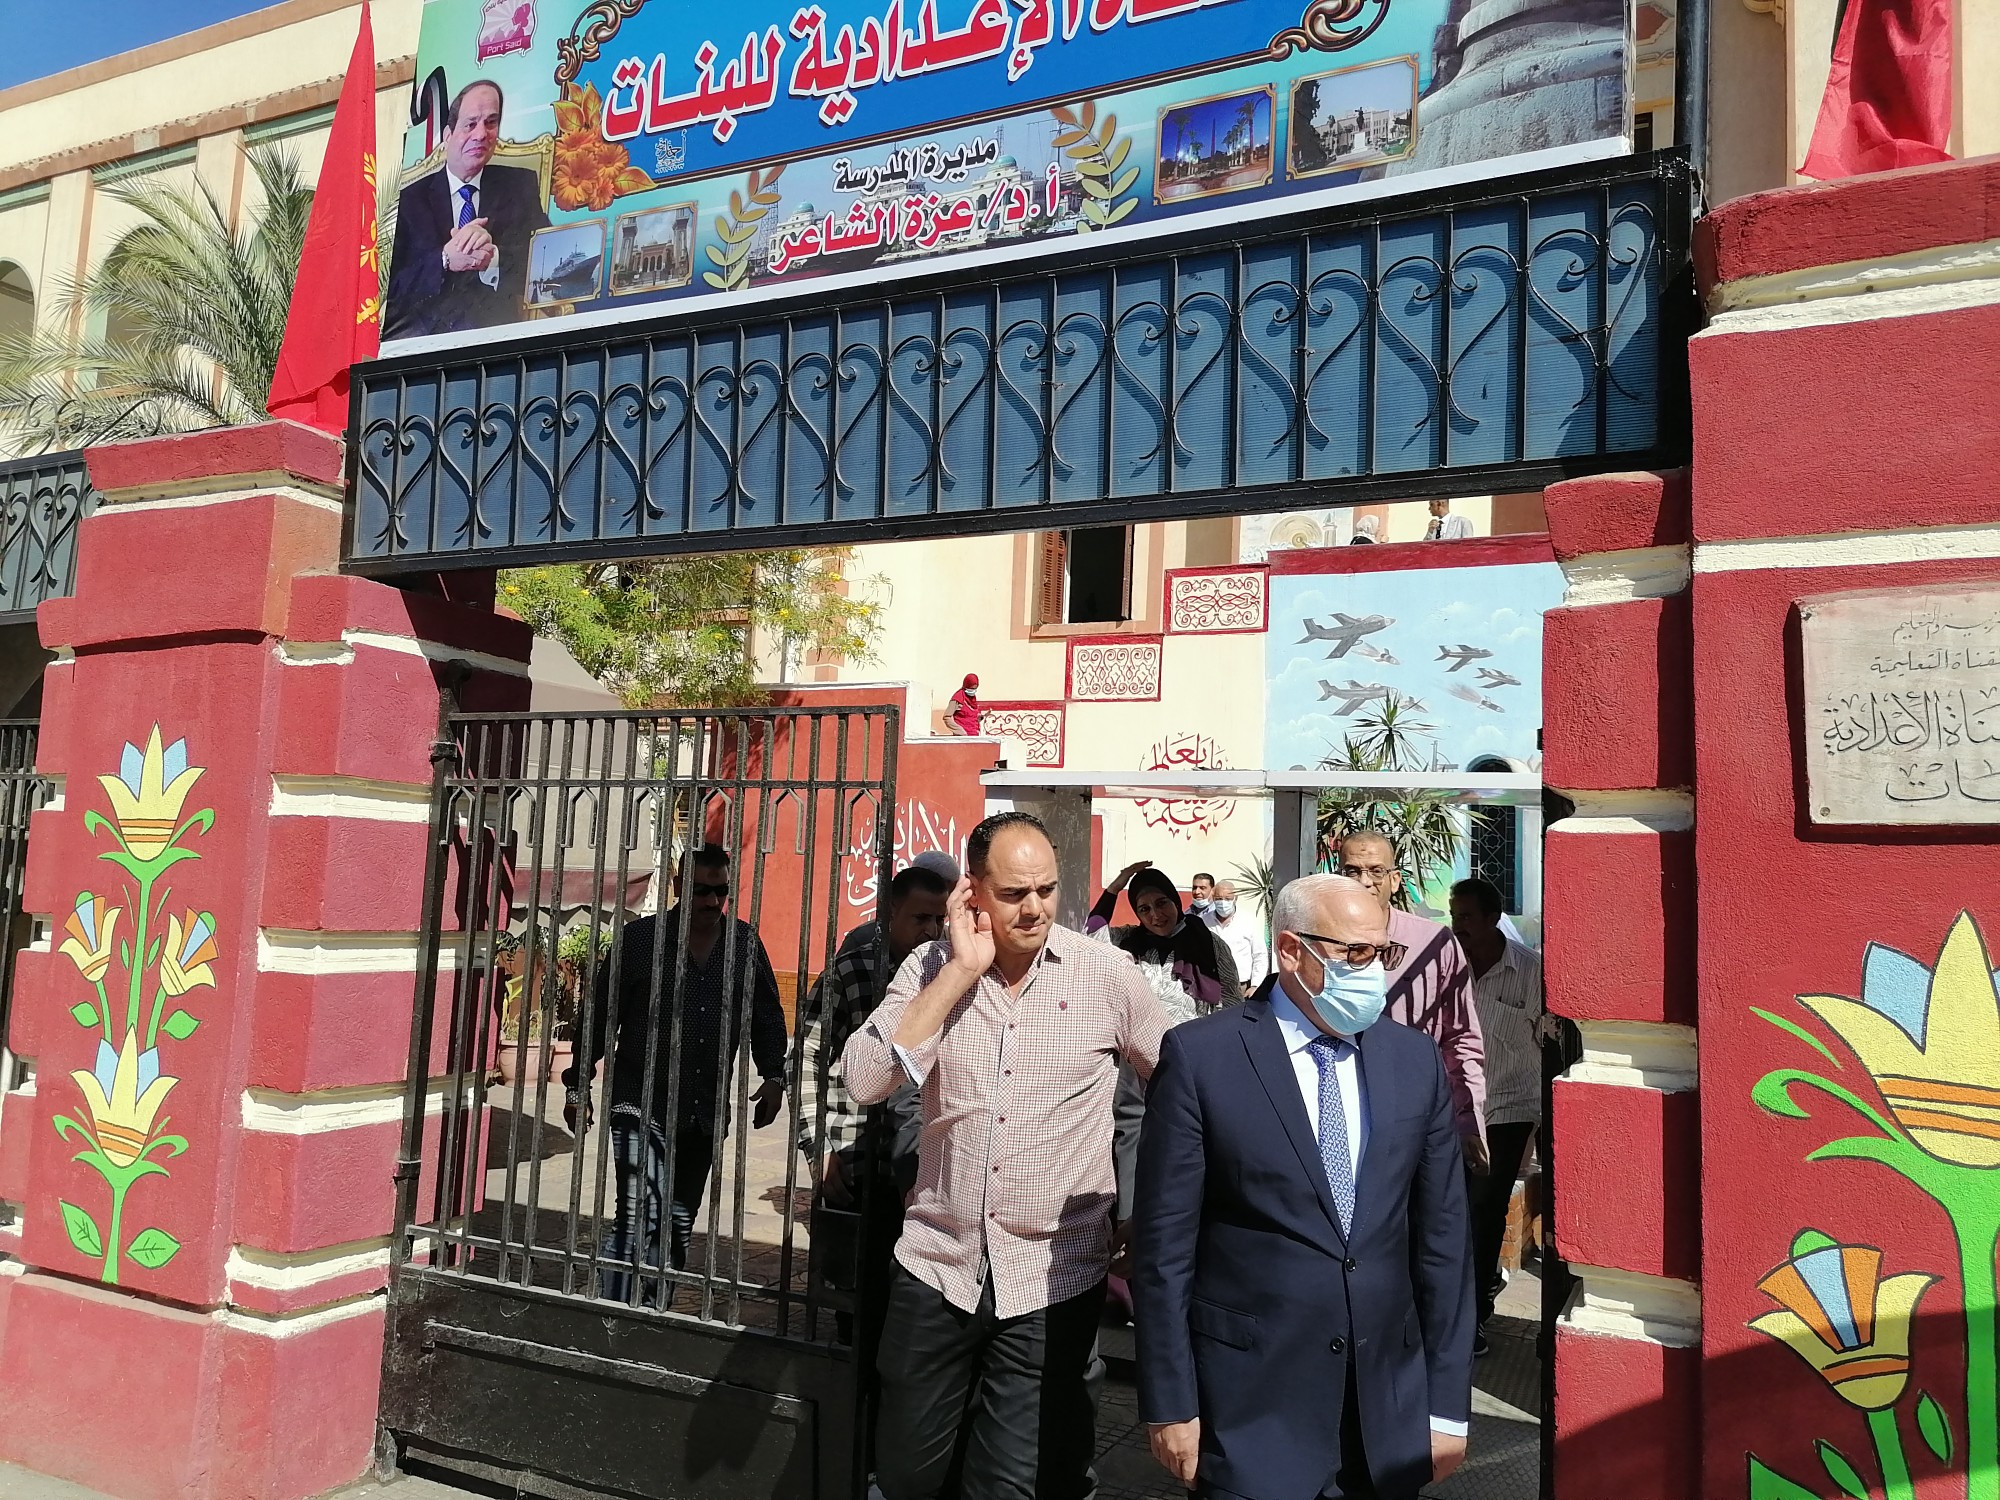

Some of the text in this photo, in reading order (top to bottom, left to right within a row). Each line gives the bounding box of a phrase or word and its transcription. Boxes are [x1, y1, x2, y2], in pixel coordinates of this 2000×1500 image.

[487, 39, 522, 54] Port Said
[602, 24, 786, 142] للبنات
[833, 136, 1000, 195] مديرة المدرسة
[767, 198, 900, 274] الشاعر
[902, 189, 978, 249] عزة
[1870, 648, 1949, 678] التعليمية
